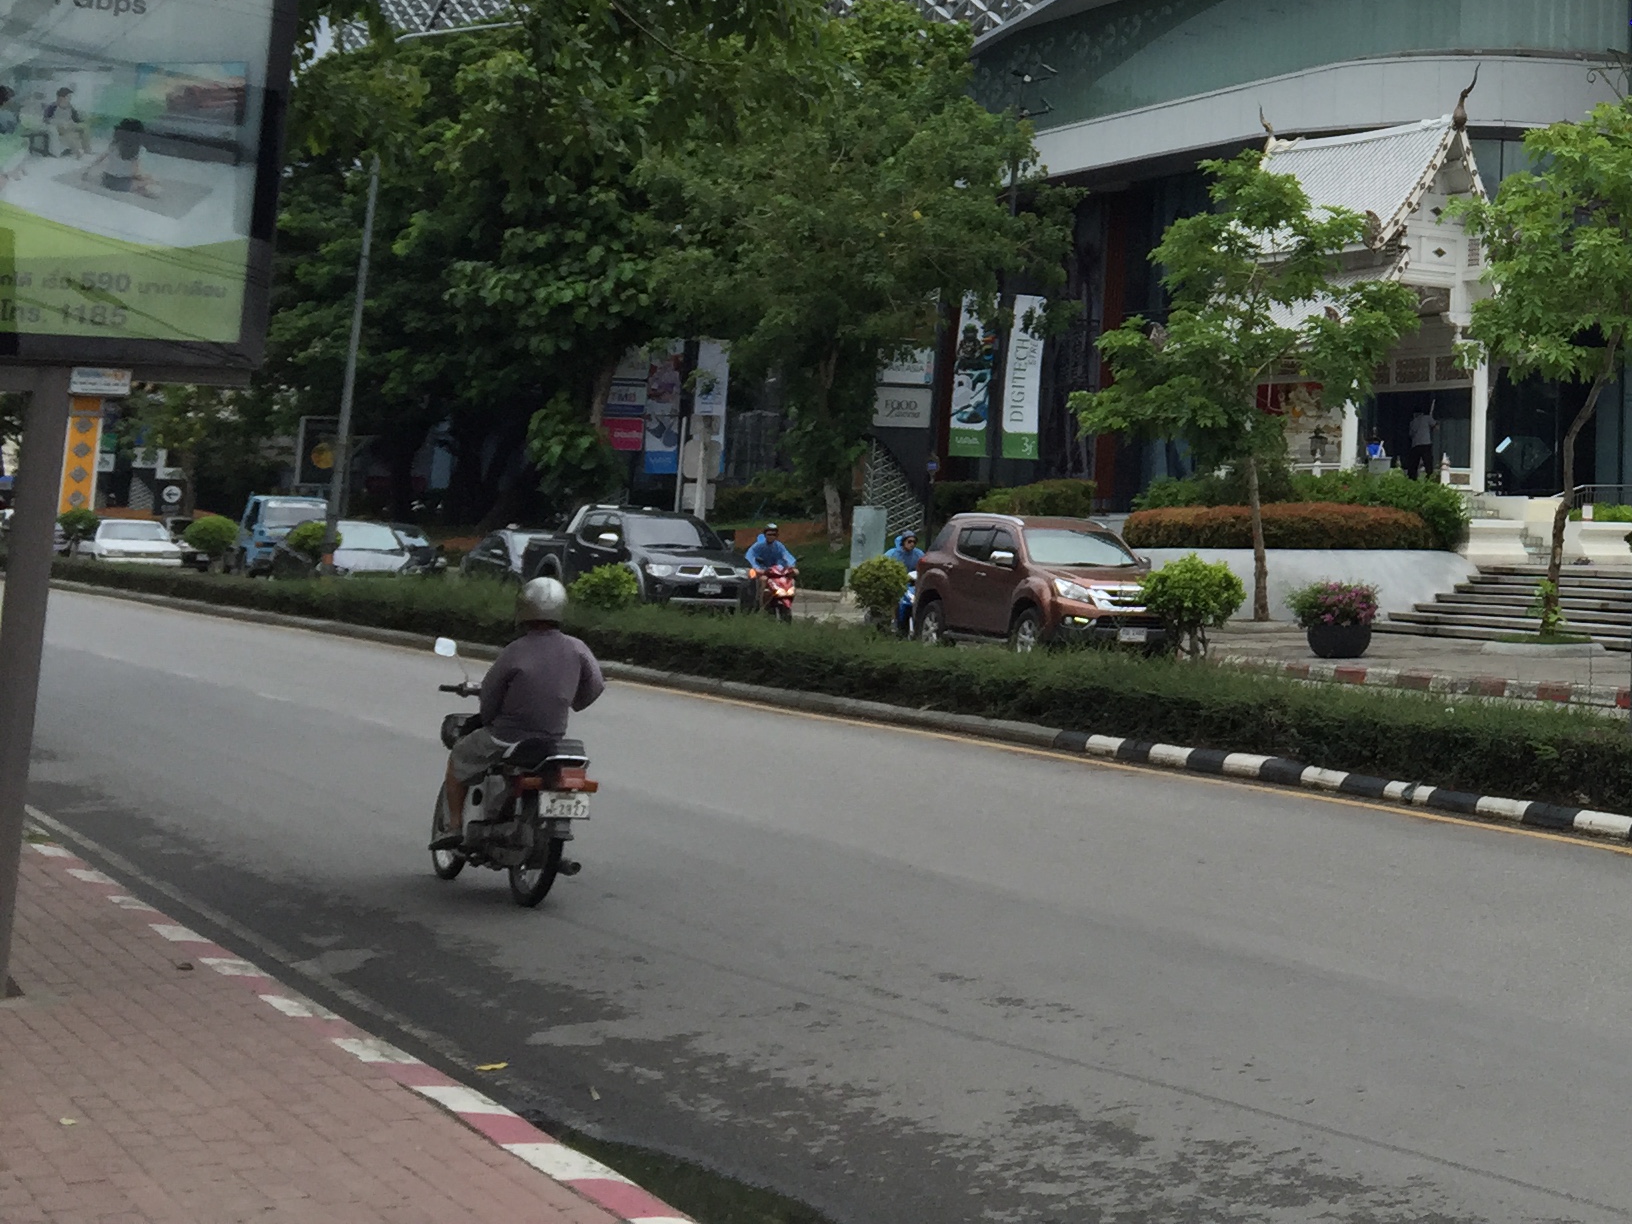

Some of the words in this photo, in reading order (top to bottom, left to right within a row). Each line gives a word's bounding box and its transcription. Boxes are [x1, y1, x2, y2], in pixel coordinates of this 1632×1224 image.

[81, 271, 131, 294] 590
[62, 303, 127, 327] 1185
[1009, 338, 1031, 423] DIGITECH
